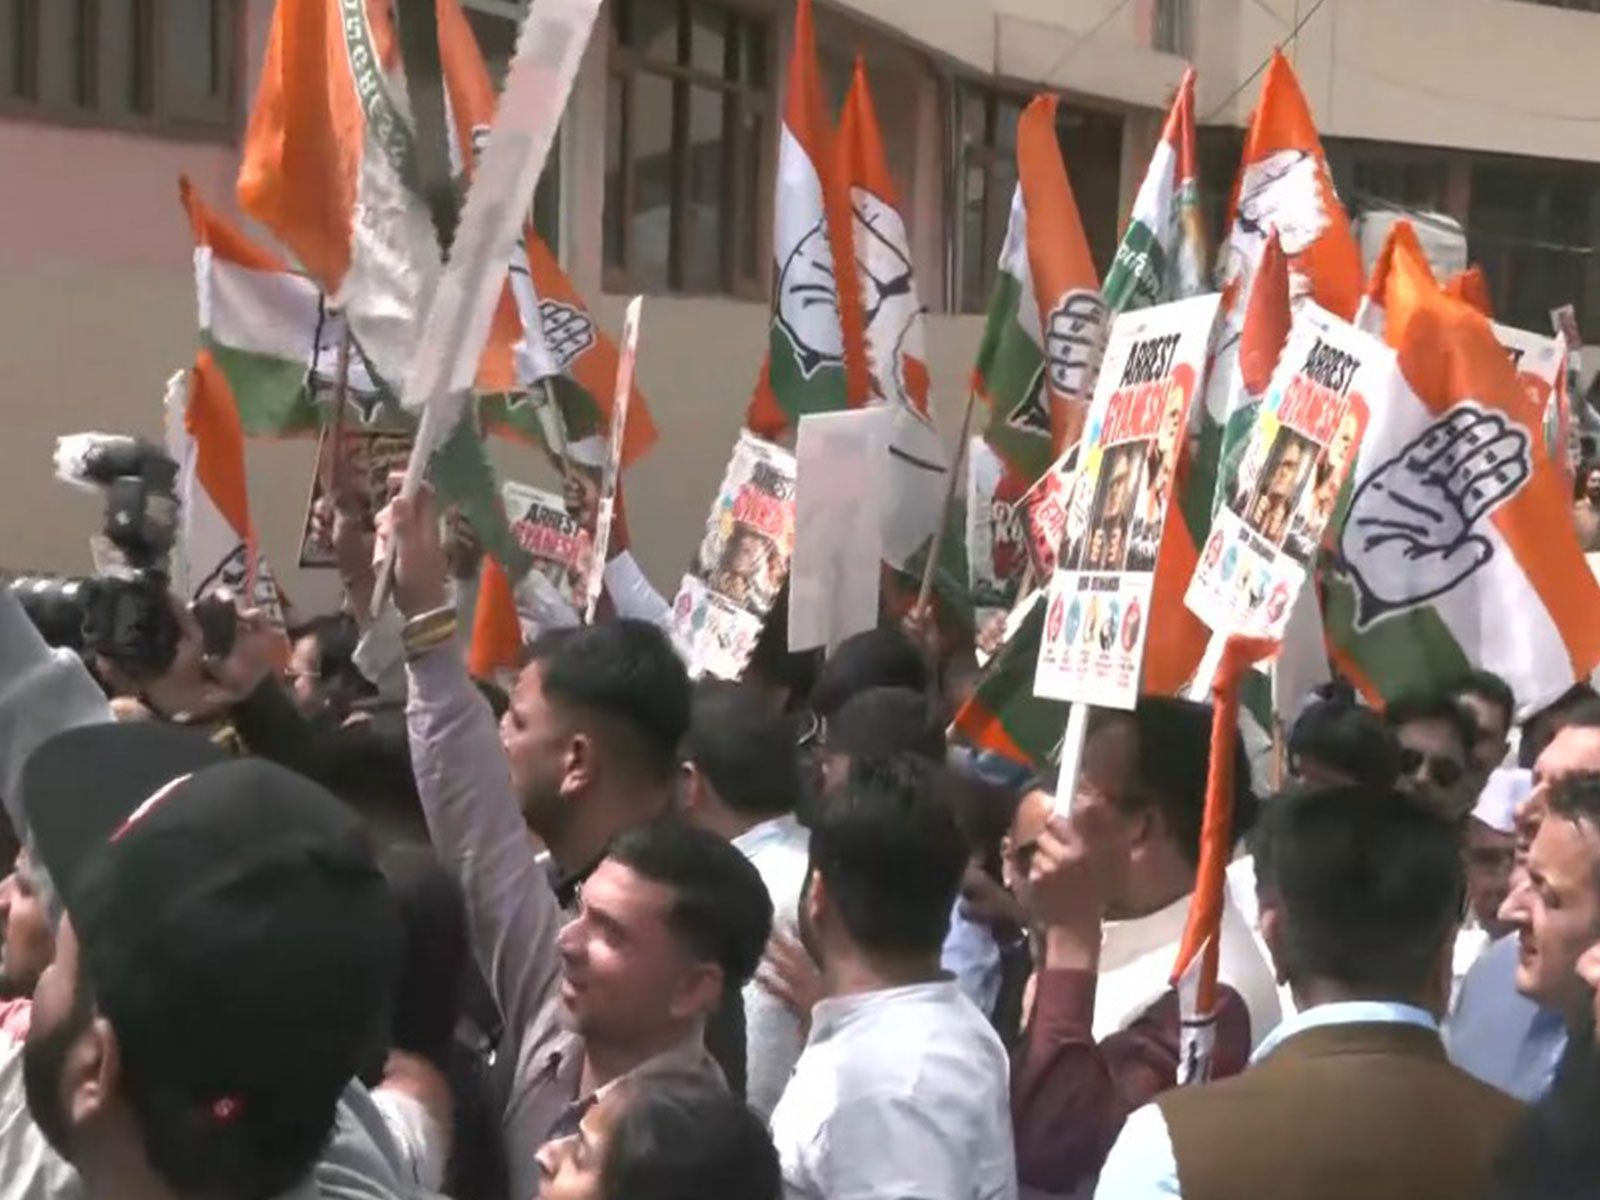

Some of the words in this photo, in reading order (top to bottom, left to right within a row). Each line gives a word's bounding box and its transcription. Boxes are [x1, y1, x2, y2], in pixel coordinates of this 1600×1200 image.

[1119, 332, 1181, 388] ARREST
[1301, 337, 1361, 399] ARREST
[523, 503, 579, 538] ARREST
